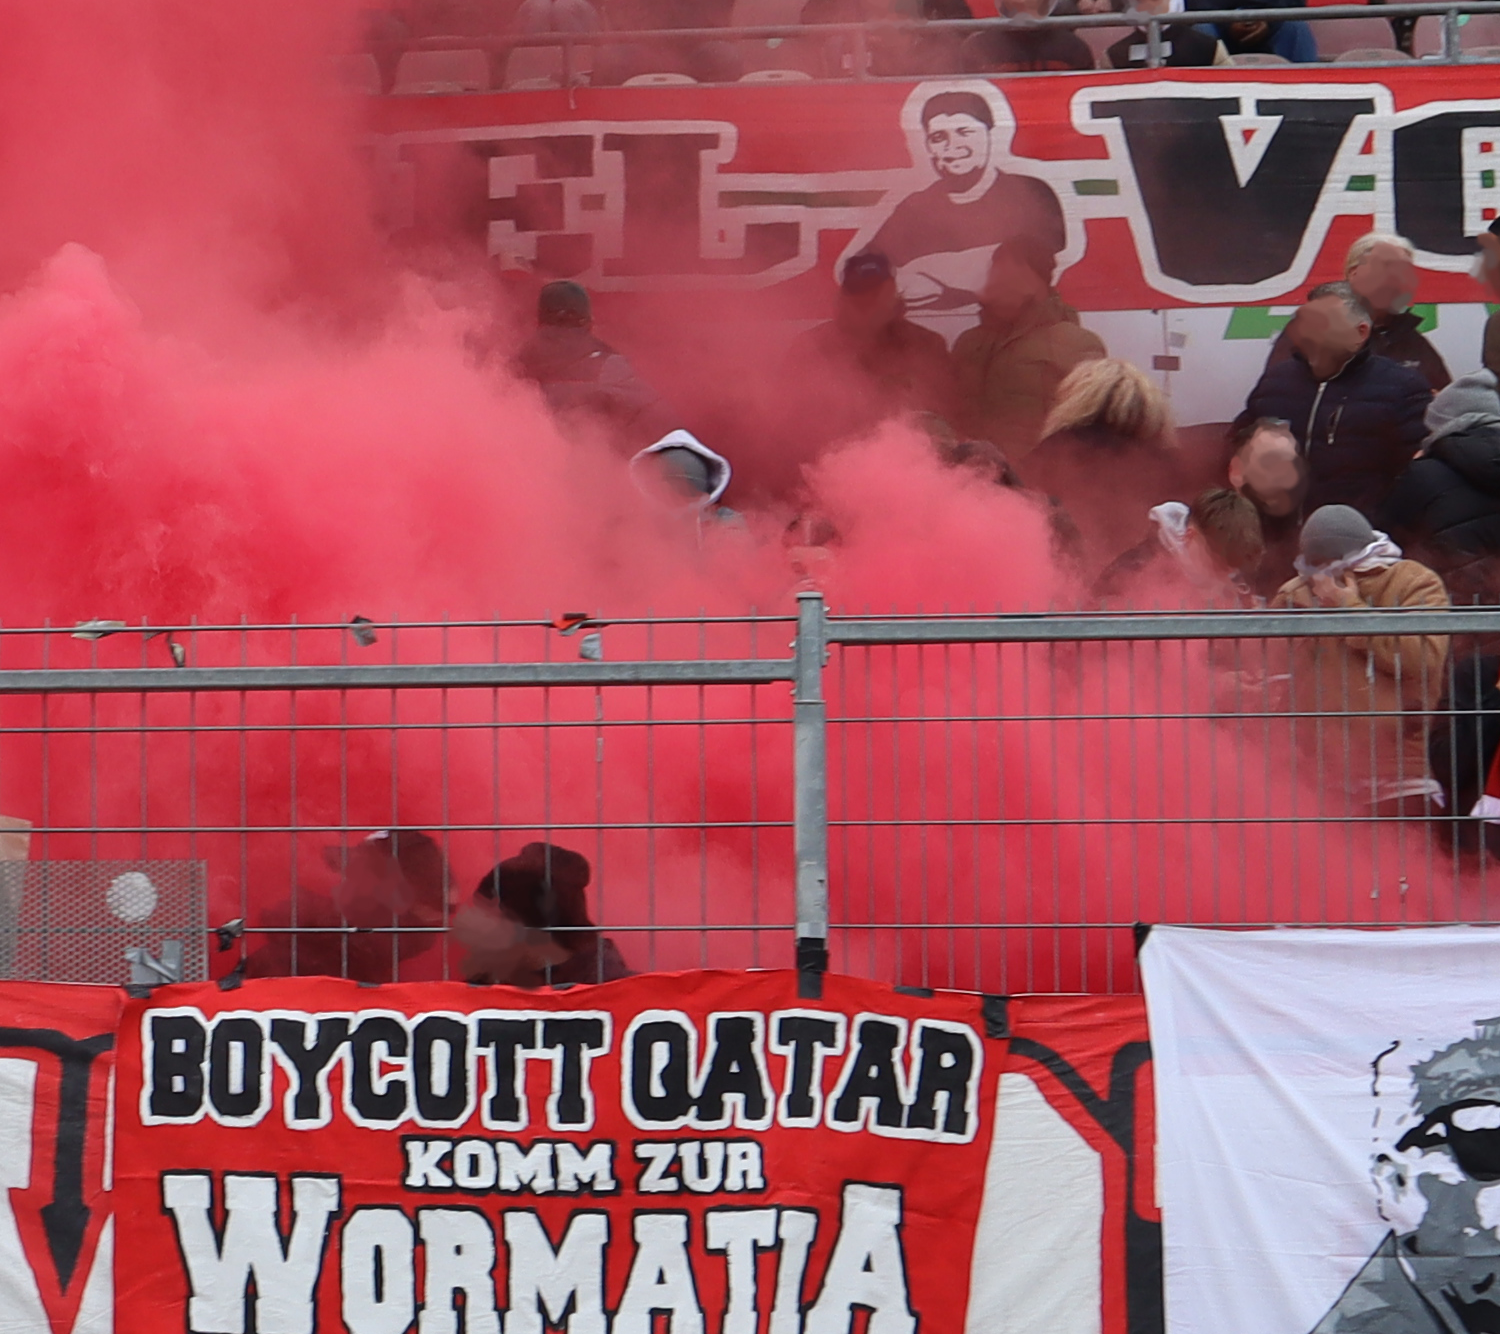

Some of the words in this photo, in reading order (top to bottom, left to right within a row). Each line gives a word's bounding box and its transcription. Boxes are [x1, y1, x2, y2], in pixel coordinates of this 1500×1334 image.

[141, 1007, 612, 1131] BOYCOTT
[623, 1009, 984, 1145] QATAR
[404, 1138, 617, 1194] KOMM
[635, 1138, 768, 1193] ZUR
